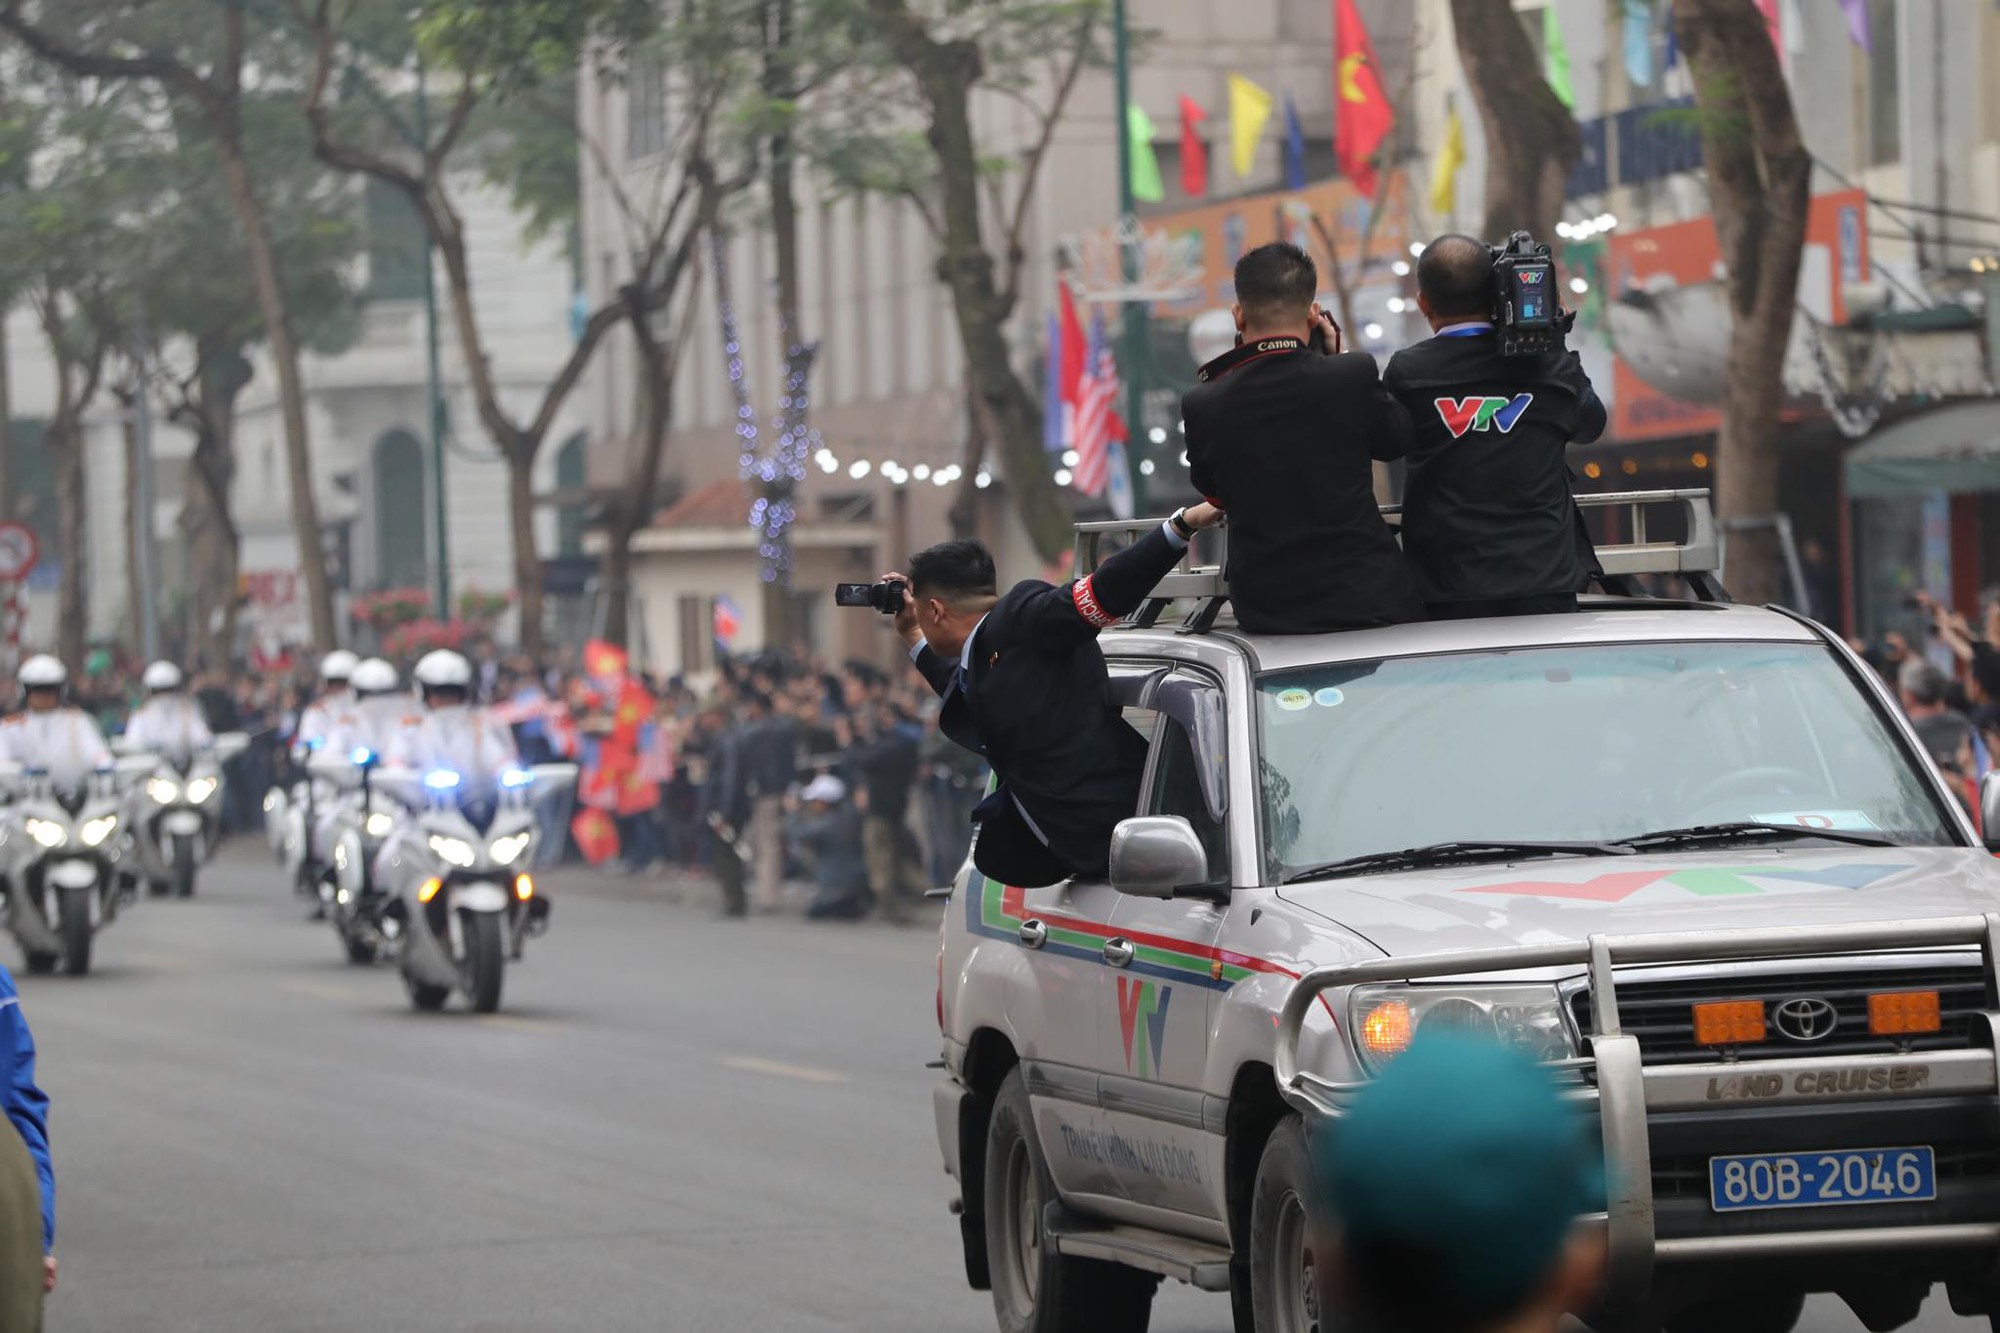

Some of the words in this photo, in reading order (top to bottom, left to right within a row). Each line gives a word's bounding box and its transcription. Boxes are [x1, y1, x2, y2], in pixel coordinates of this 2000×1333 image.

[1519, 272, 1544, 284] VTV
[1257, 340, 1298, 352] Canon
[1434, 393, 1534, 438] VTV
[1075, 589, 1111, 627] OFFICIAL
[1452, 864, 1917, 902] VTV
[1117, 976, 1172, 1082] VTV
[1706, 1074, 1783, 1100] LAND
[1794, 1065, 1930, 1094] CRUISER
[1724, 1153, 1922, 1203] 80B-2046
